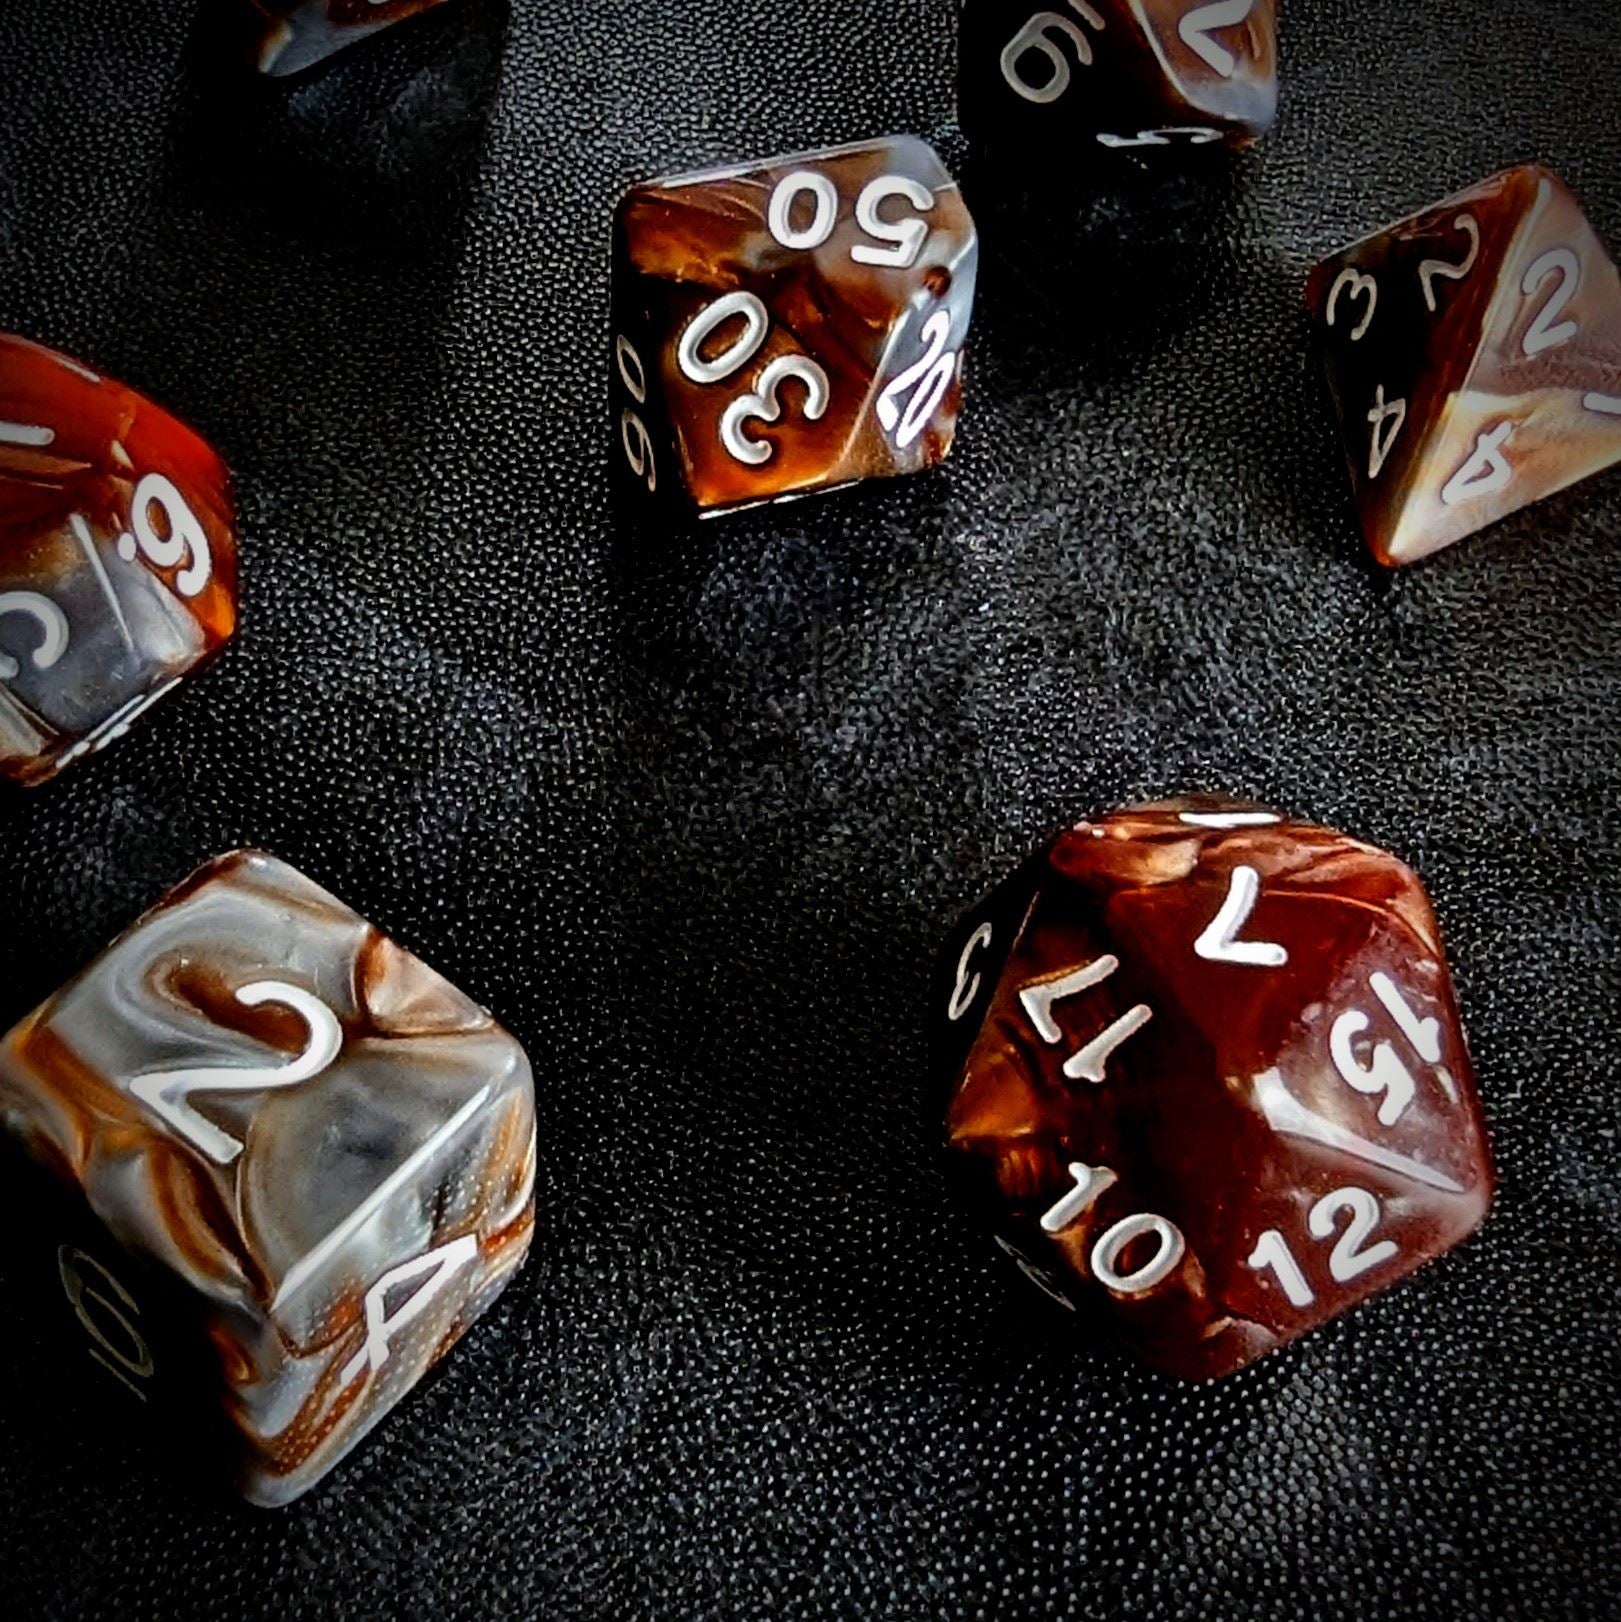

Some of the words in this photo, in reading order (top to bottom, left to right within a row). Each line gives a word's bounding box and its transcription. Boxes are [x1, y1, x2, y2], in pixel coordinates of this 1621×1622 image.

[767, 170, 935, 268] 50
[1326, 268, 1378, 341] 3
[1520, 247, 1581, 358] 2
[677, 290, 830, 464] 30
[875, 309, 956, 448] 20
[1367, 383, 1406, 480] 4
[1441, 420, 1513, 504] 4
[1194, 866, 1288, 966] 7
[128, 980, 343, 1164] 2
[1019, 954, 1153, 1084] 17
[1328, 970, 1441, 1126] 15
[1040, 1161, 1186, 1293] 10
[1247, 1186, 1399, 1308] 12
[340, 1234, 479, 1385] 4
